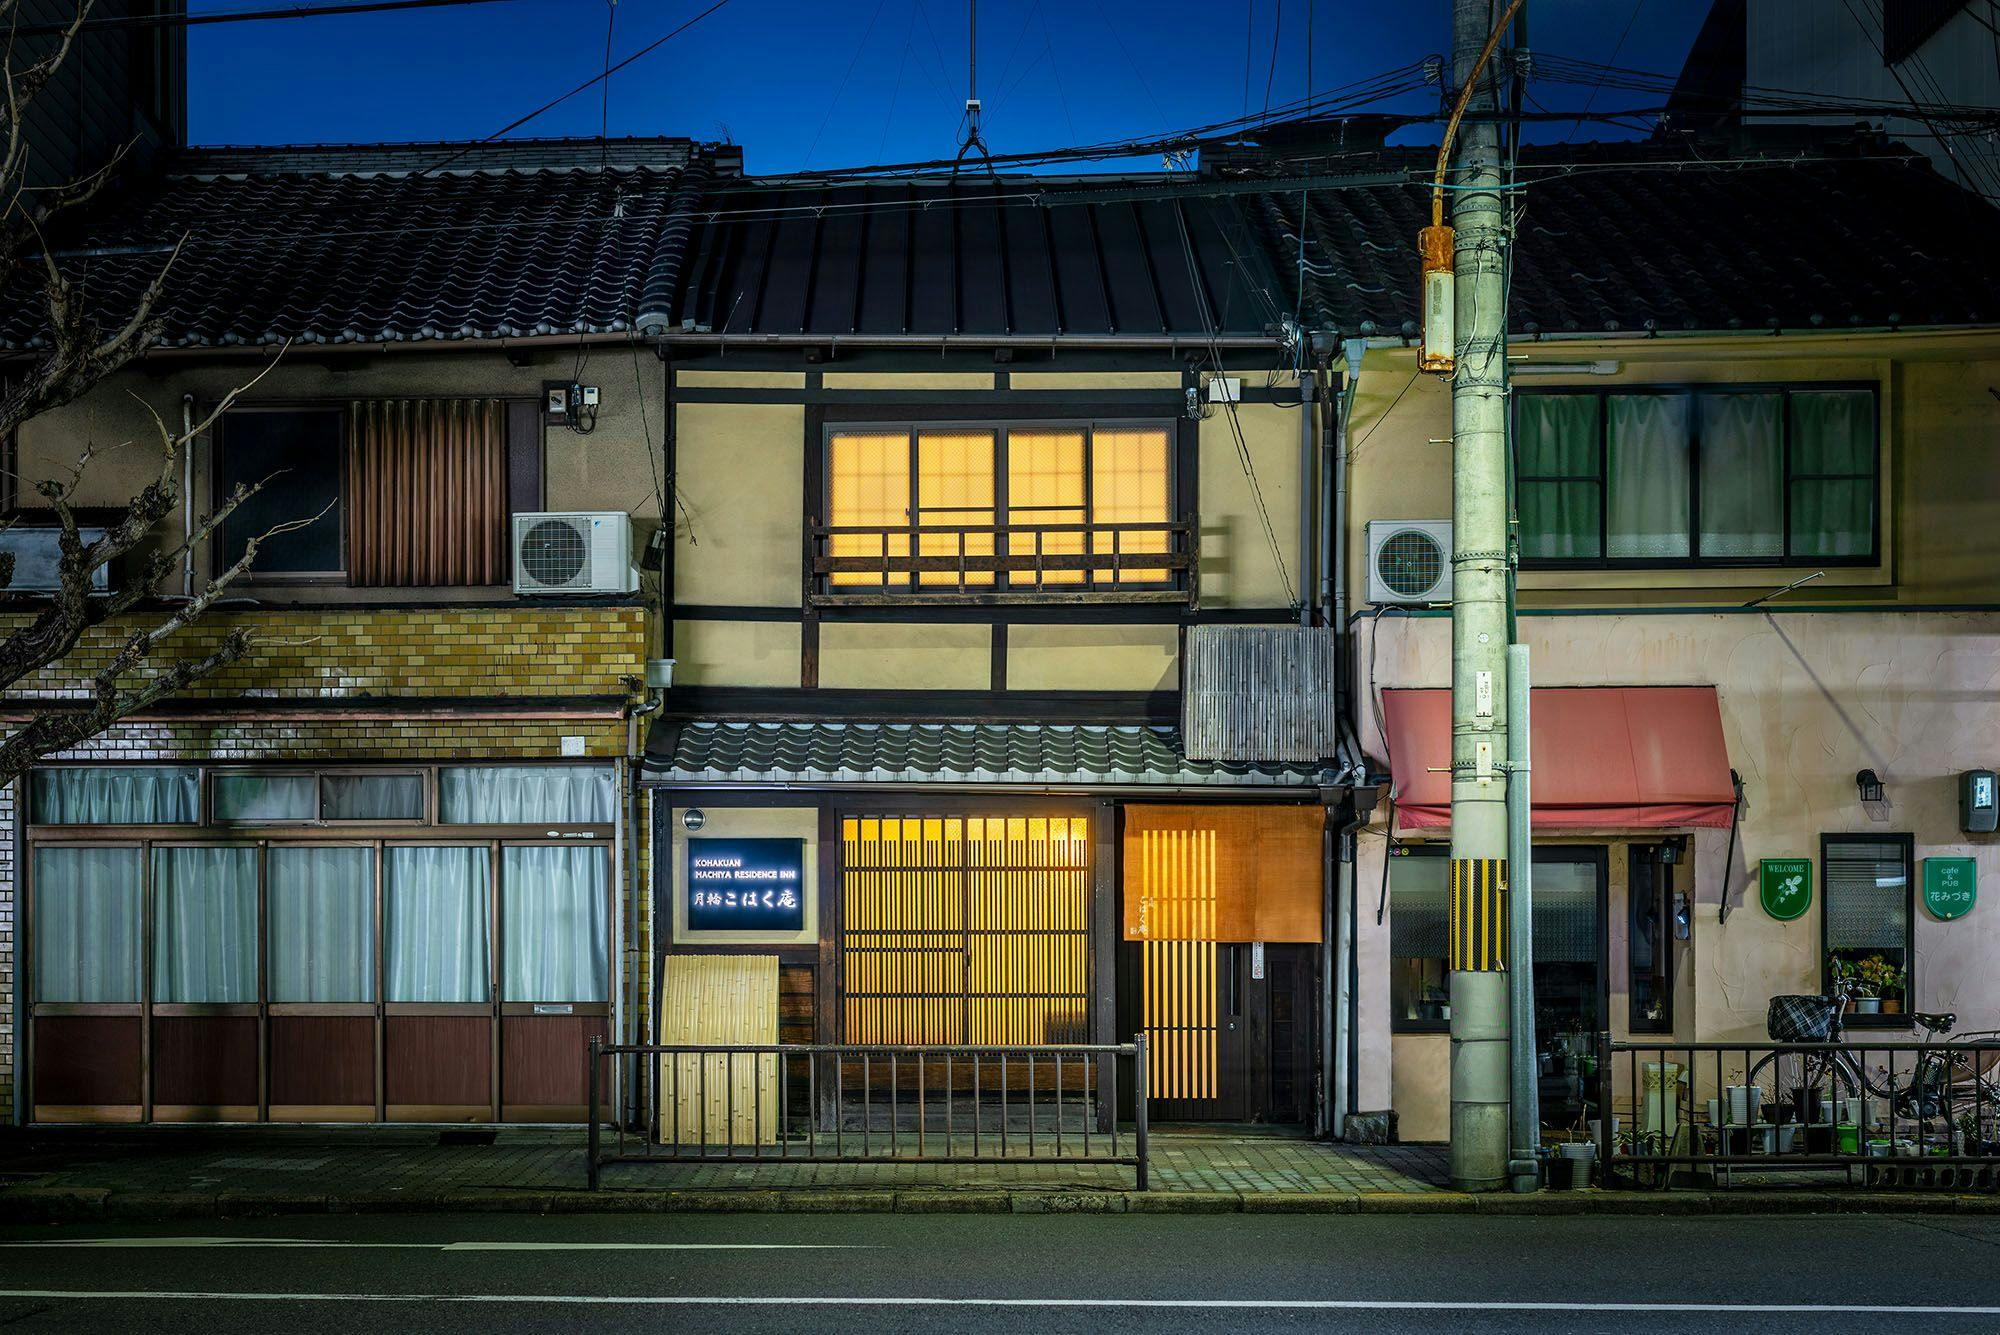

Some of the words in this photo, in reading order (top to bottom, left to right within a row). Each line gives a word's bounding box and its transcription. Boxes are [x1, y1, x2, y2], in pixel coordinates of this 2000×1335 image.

[695, 859, 741, 867] KOHAKUAN
[1768, 864, 1804, 873] WELCOME
[695, 871, 731, 879] MACHIYA
[735, 871, 777, 879] RESIDENCE
[780, 871, 795, 879] INN
[1930, 891, 1971, 902] 花みづき
